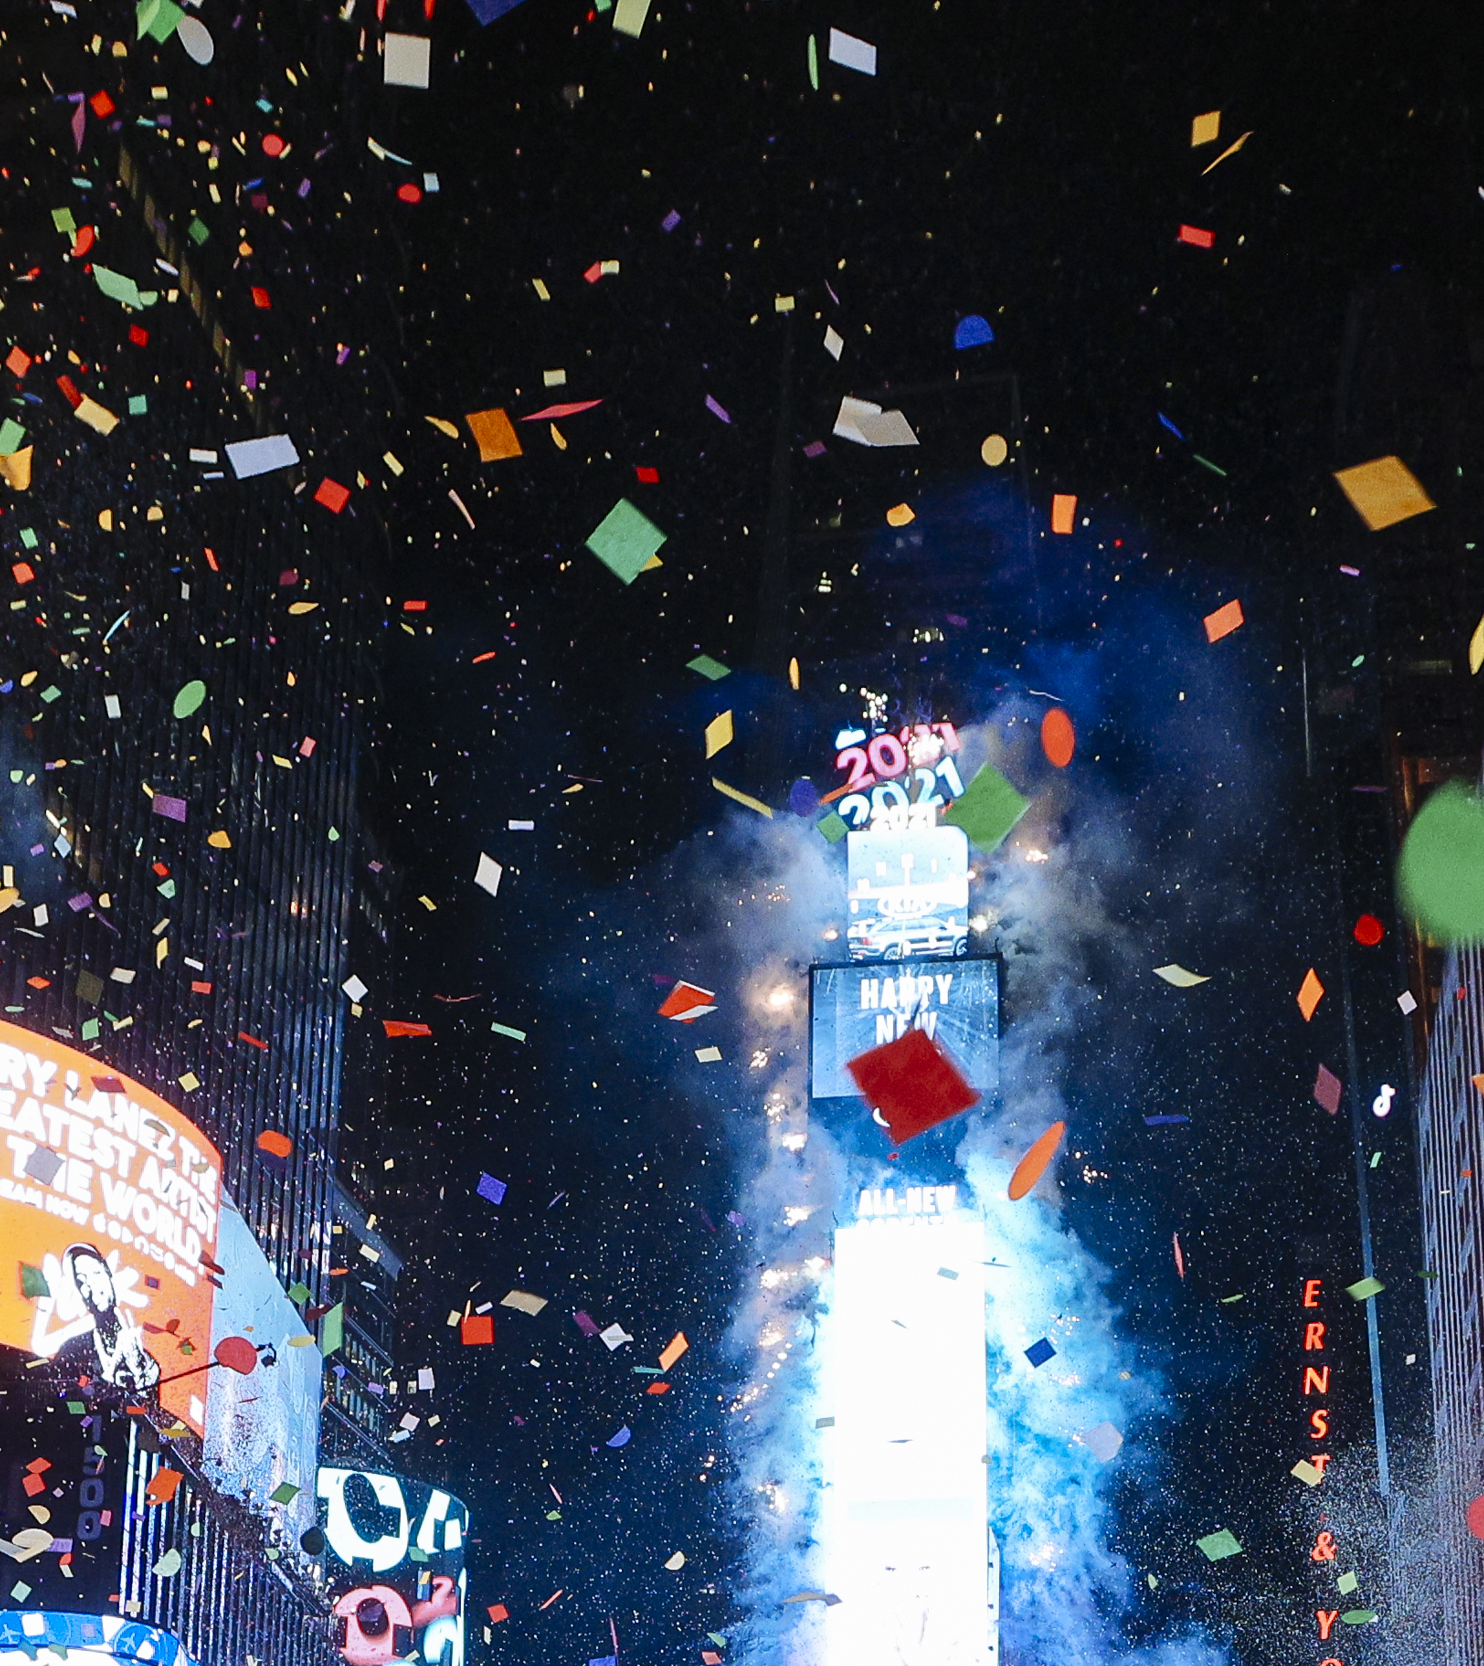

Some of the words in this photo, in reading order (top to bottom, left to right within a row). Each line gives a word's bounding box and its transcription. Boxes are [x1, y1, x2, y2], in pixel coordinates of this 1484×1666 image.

[860, 973, 952, 1010] HAPPY
[6, 1135, 93, 1203] TE
[139, 1156, 216, 1243] ARTIST
[858, 1185, 956, 1215] ALL-NEW
[1311, 1531, 1338, 1561] &
